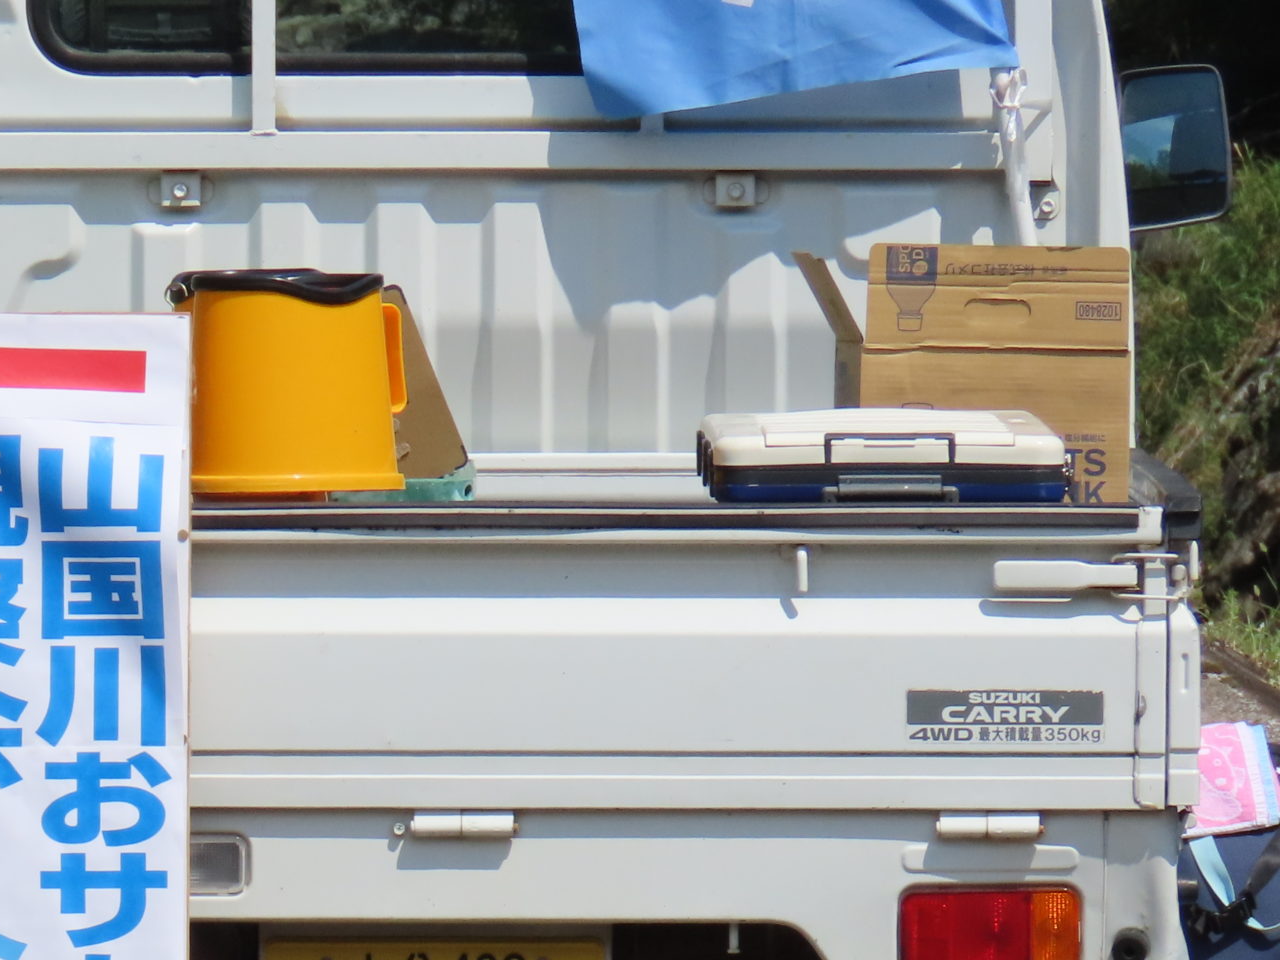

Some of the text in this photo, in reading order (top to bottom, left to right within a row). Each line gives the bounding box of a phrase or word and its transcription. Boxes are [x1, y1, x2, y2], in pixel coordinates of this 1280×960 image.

[968, 692, 1041, 705] SUZUKI
[941, 705, 1070, 723] CARRY
[909, 727, 973, 741] 4WD
